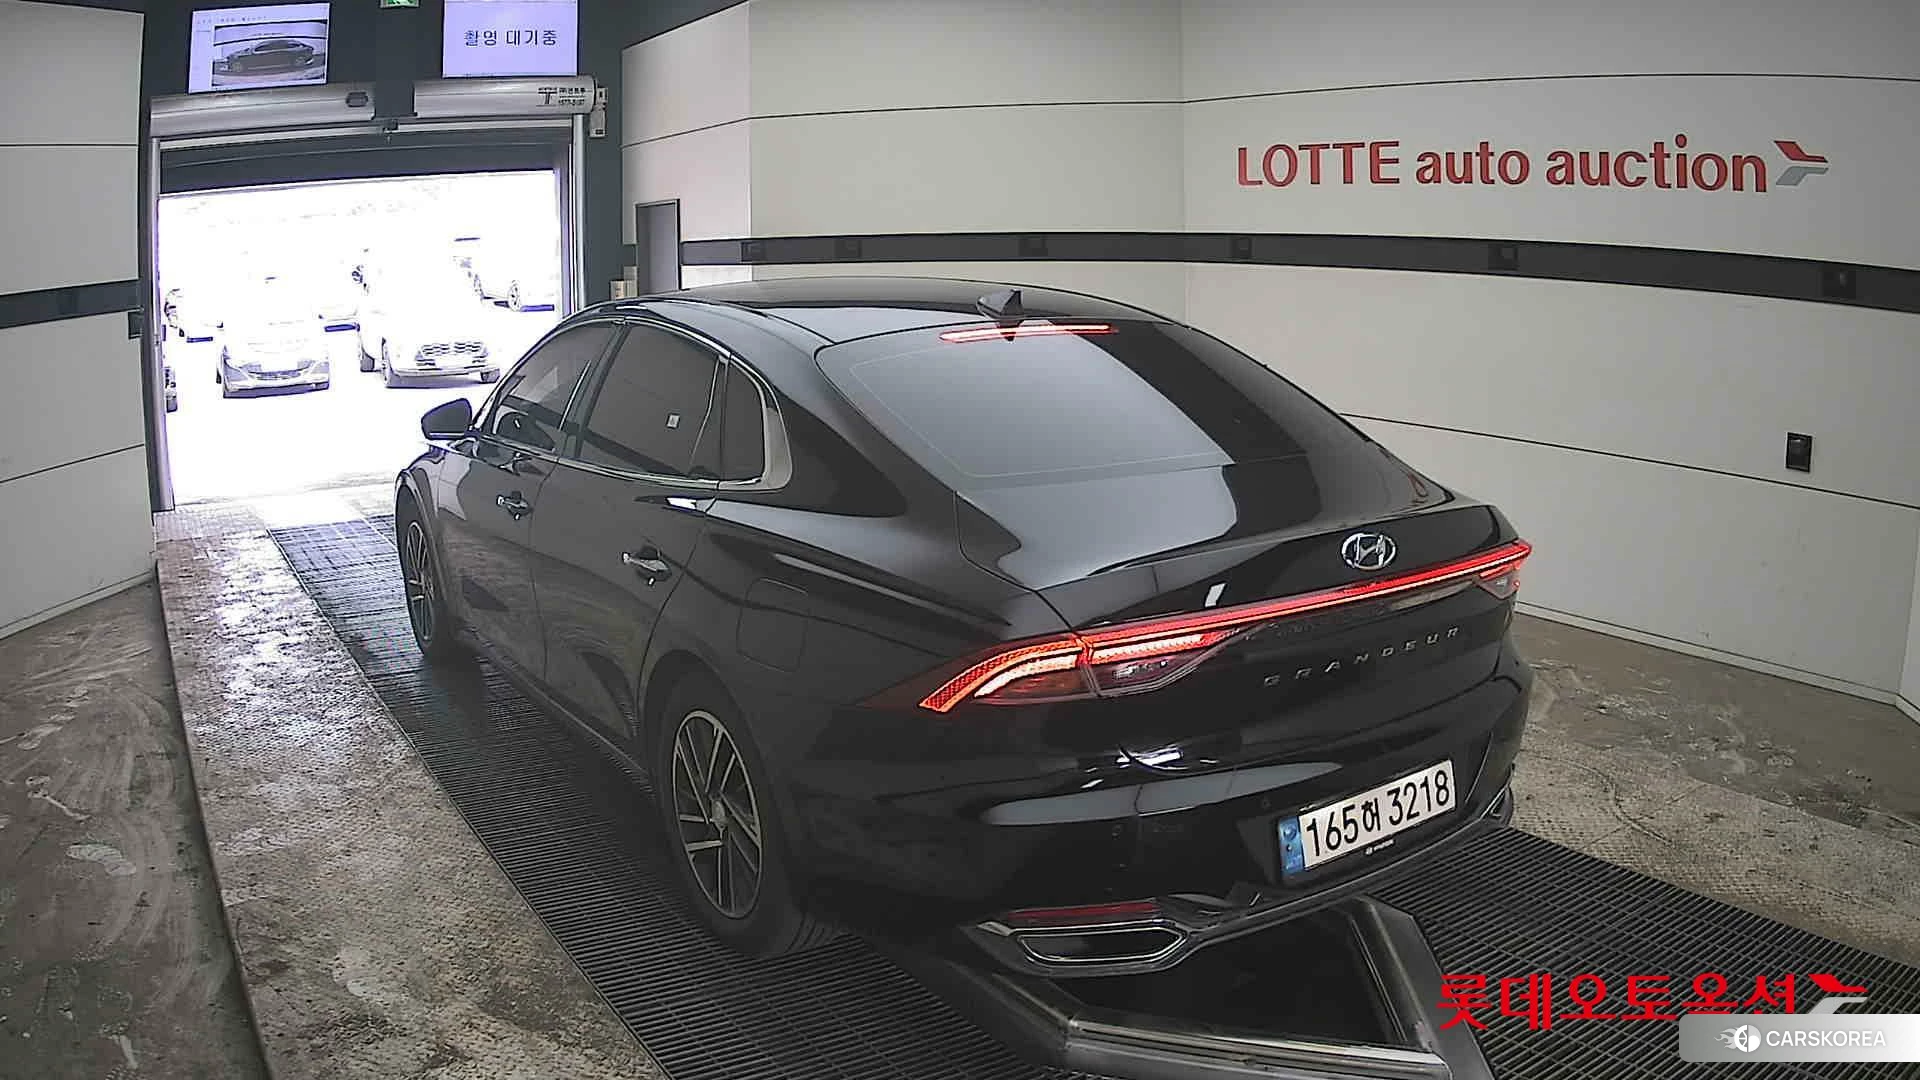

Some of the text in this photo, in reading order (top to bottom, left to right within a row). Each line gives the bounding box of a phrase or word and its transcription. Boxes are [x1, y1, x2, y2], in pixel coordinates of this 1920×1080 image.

[463, 30, 556, 46] 촬영 대기중
[1237, 134, 1767, 193] LOTTE auto auction
[1264, 626, 1459, 687] GRANDEUR
[1306, 769, 1450, 857] 165허 3218
